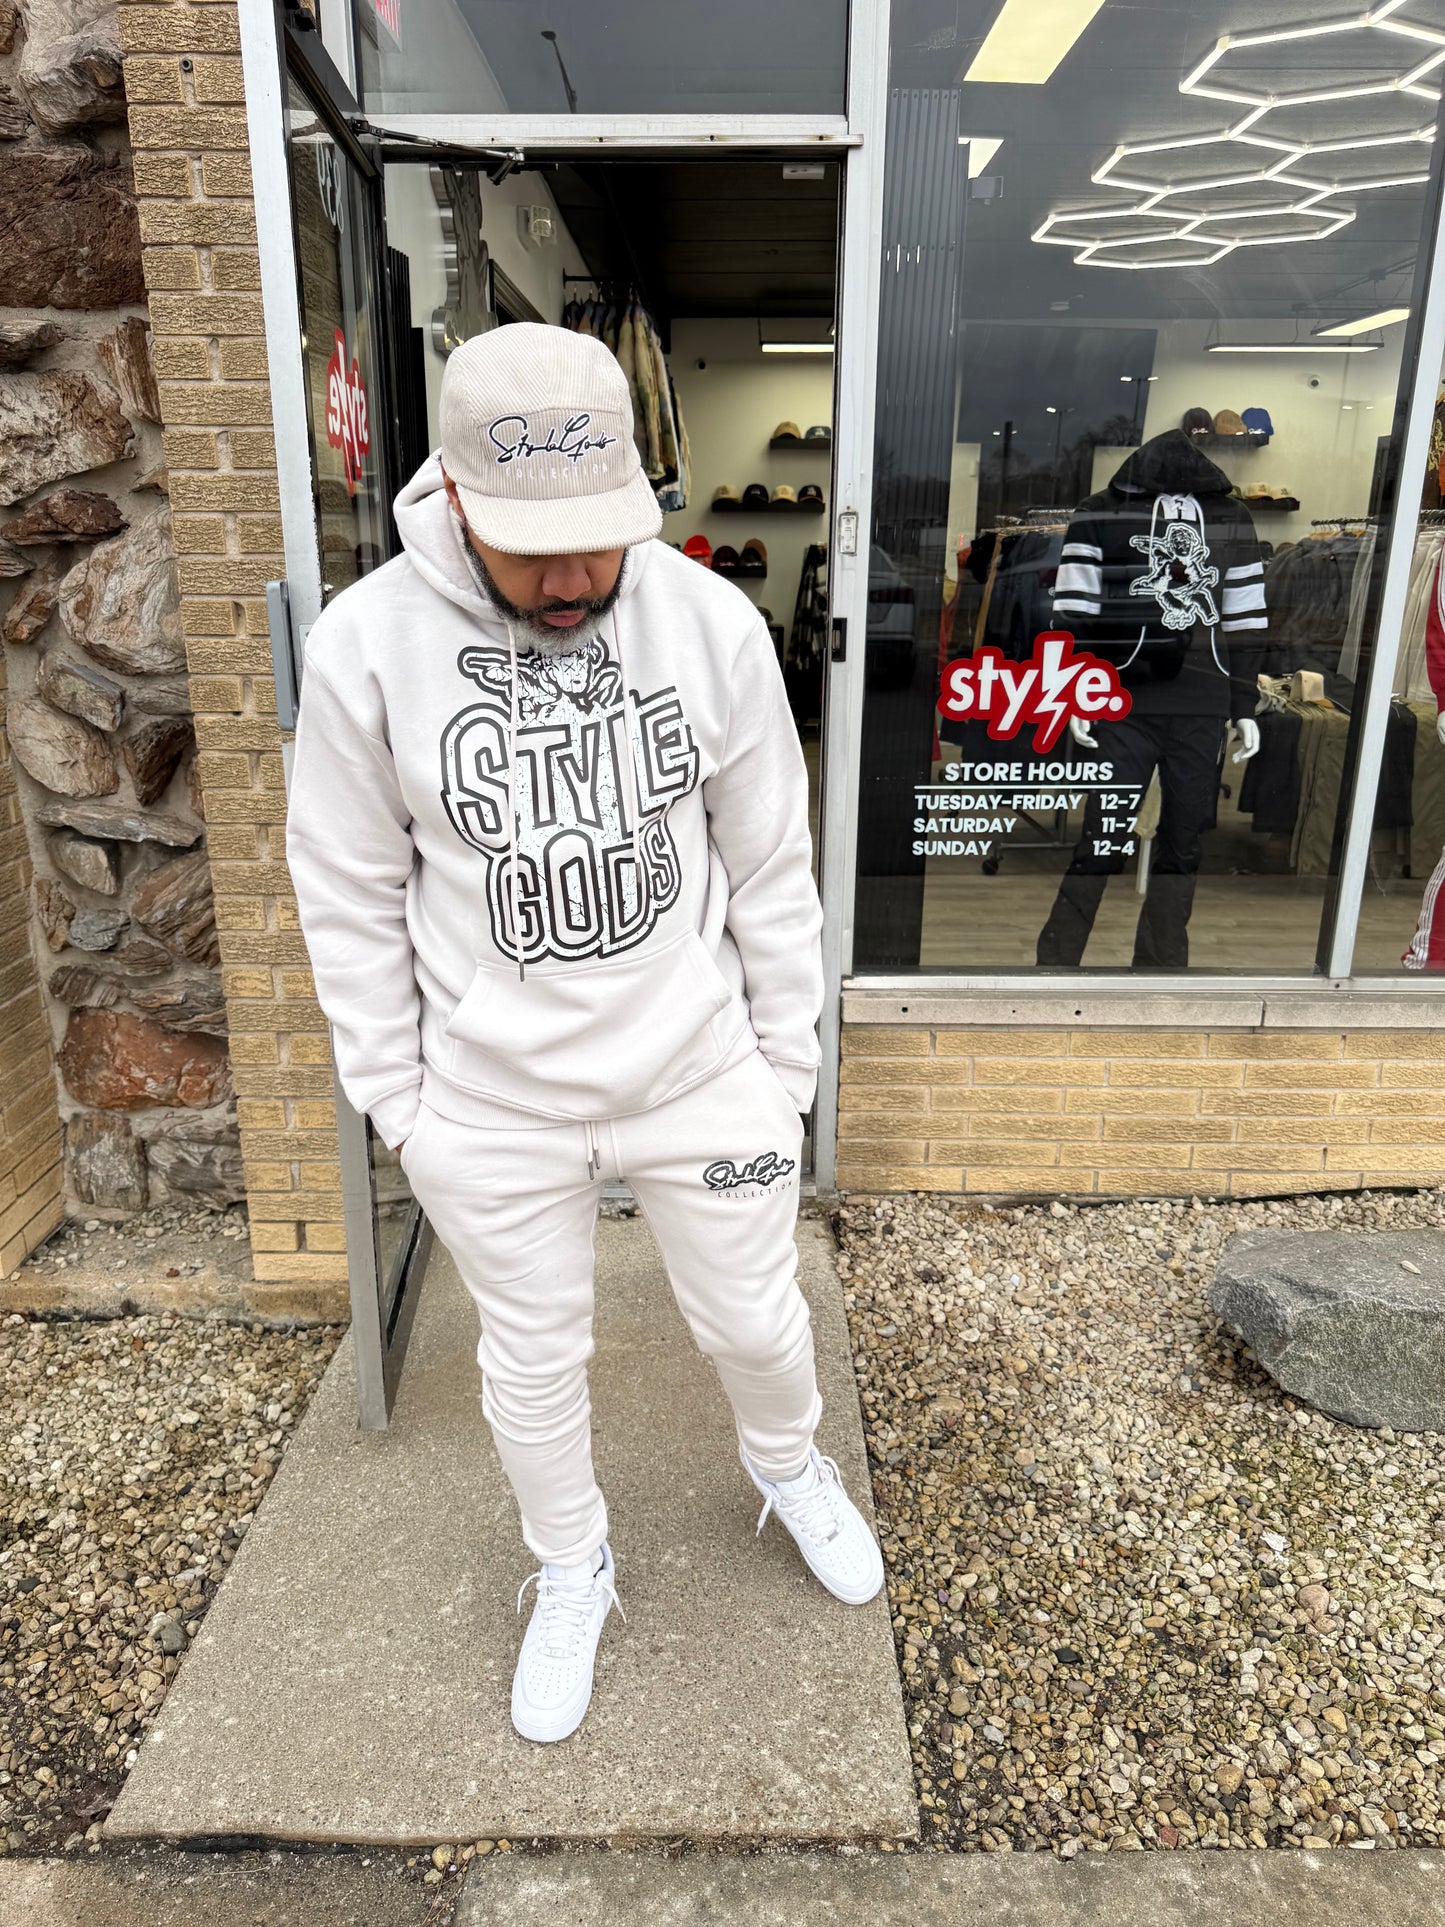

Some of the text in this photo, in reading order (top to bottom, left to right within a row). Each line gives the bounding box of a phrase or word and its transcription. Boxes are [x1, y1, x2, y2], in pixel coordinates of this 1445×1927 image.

[506, 464, 608, 480] COLLECTION
[447, 690, 697, 852] STYLE
[944, 762, 1114, 782] STORE HOURS
[915, 794, 1140, 811] TUESDAY-FRIDAY 12-7
[913, 817, 1138, 834] SATURDAY 11-7
[912, 841, 1135, 856] SUNDAY 12-4
[490, 820, 679, 958] GODS
[717, 1182, 792, 1198] COLLECTION
